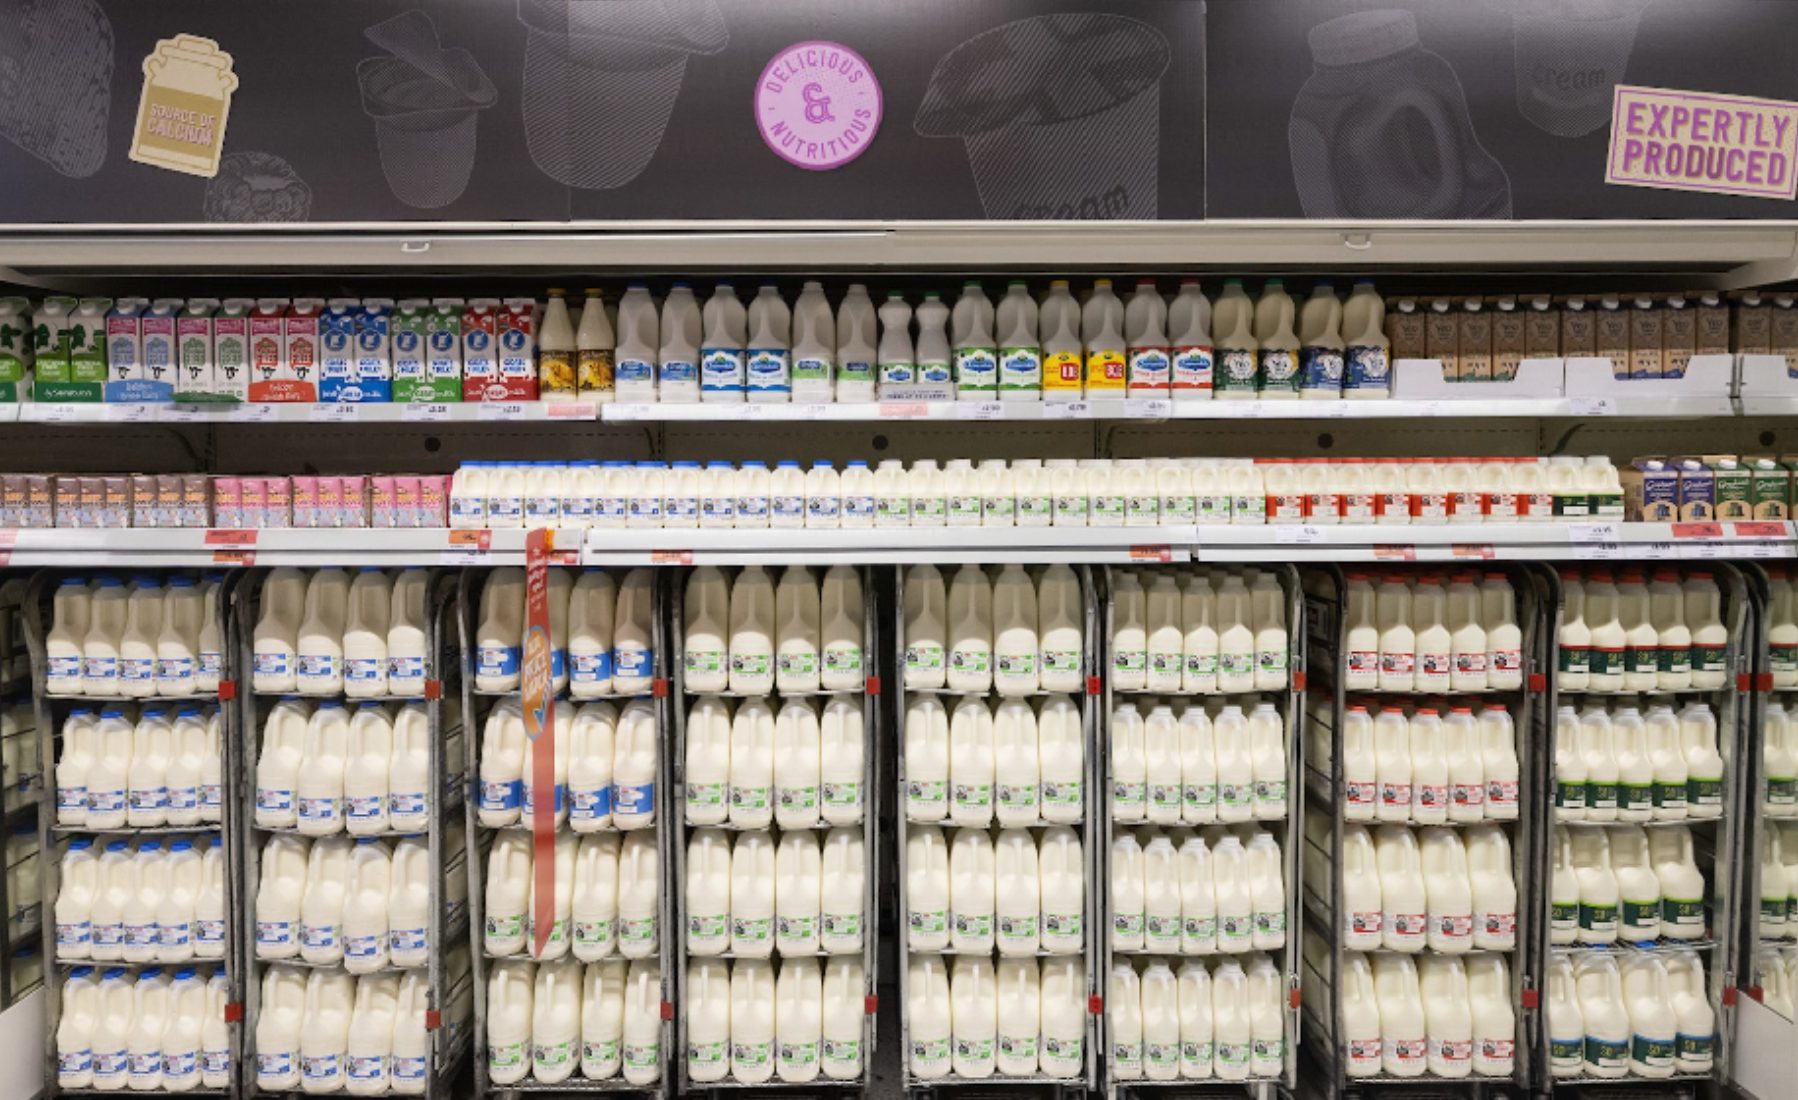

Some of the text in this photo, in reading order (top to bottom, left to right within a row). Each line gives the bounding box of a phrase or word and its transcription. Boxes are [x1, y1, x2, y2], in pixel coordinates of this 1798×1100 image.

[766, 49, 863, 93] DELICIOUS
[152, 104, 216, 130] SOURCE OF
[803, 82, 836, 124] &
[1625, 101, 1790, 149] EXPERTLY
[770, 108, 871, 159] NUTRITIOUS
[1622, 138, 1787, 186] PRODUCED
